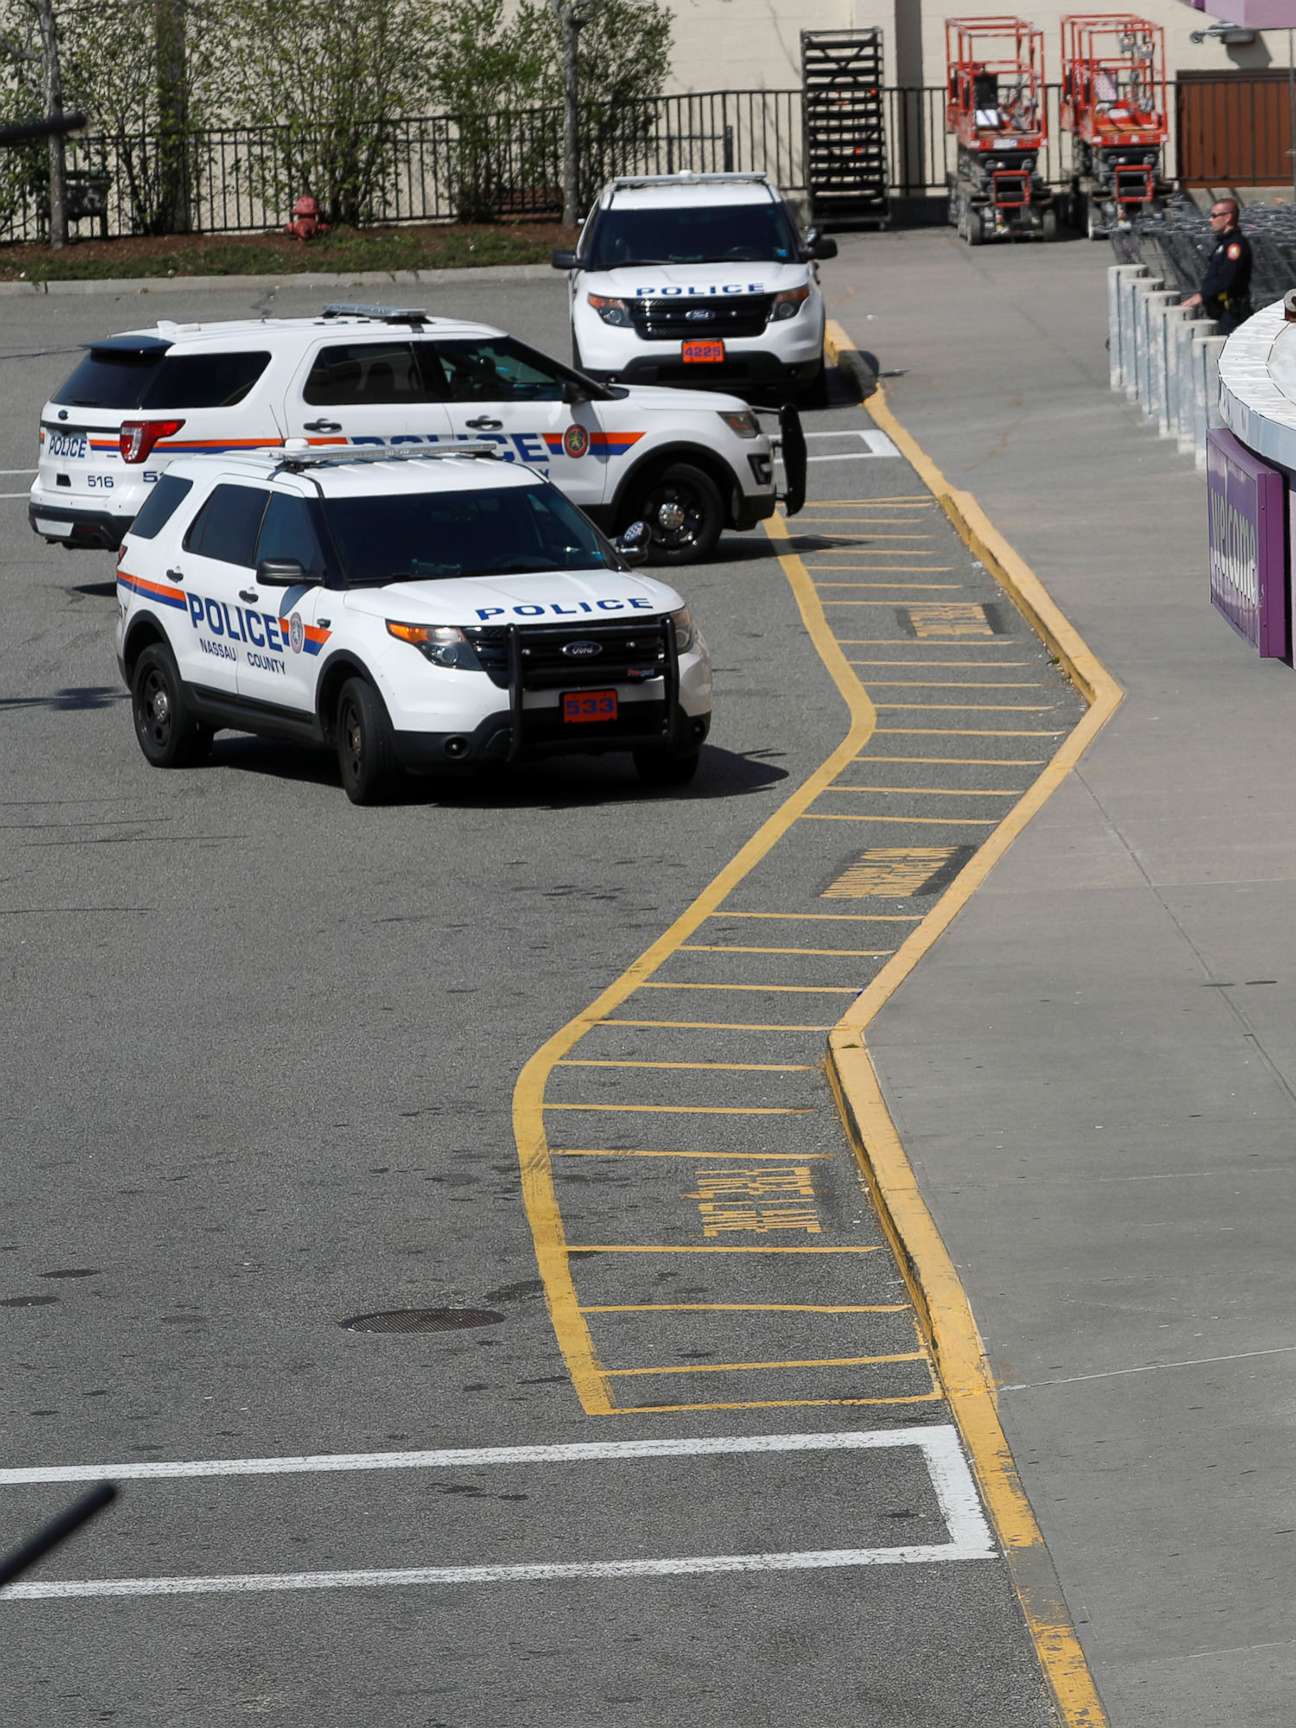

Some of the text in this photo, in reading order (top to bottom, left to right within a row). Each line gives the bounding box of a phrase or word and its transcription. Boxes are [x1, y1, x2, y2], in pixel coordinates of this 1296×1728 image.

[636, 282, 765, 297] POLICE
[48, 435, 87, 458] POLICE
[87, 475, 114, 488] 516
[475, 597, 654, 621] POLICE
[187, 592, 283, 652] POLICE
[199, 638, 286, 675] NASSAU COUNTY
[566, 697, 615, 716] 533
[695, 1167, 822, 1238] FIRE LANE
